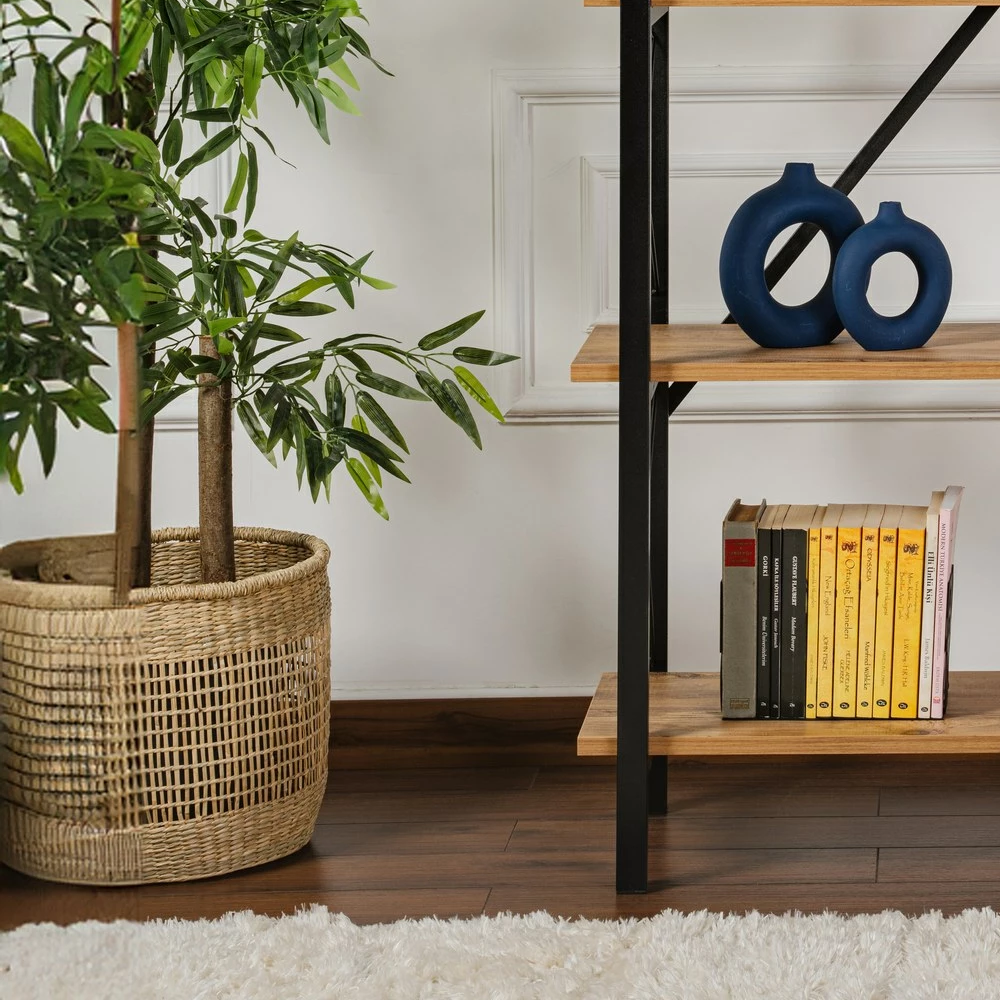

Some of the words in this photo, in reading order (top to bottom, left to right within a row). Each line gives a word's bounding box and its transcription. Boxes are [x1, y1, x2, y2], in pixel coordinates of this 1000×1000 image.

[927, 551, 935, 565] Elli
[926, 566, 936, 587] Ünlü
[924, 588, 933, 604] Kişi
